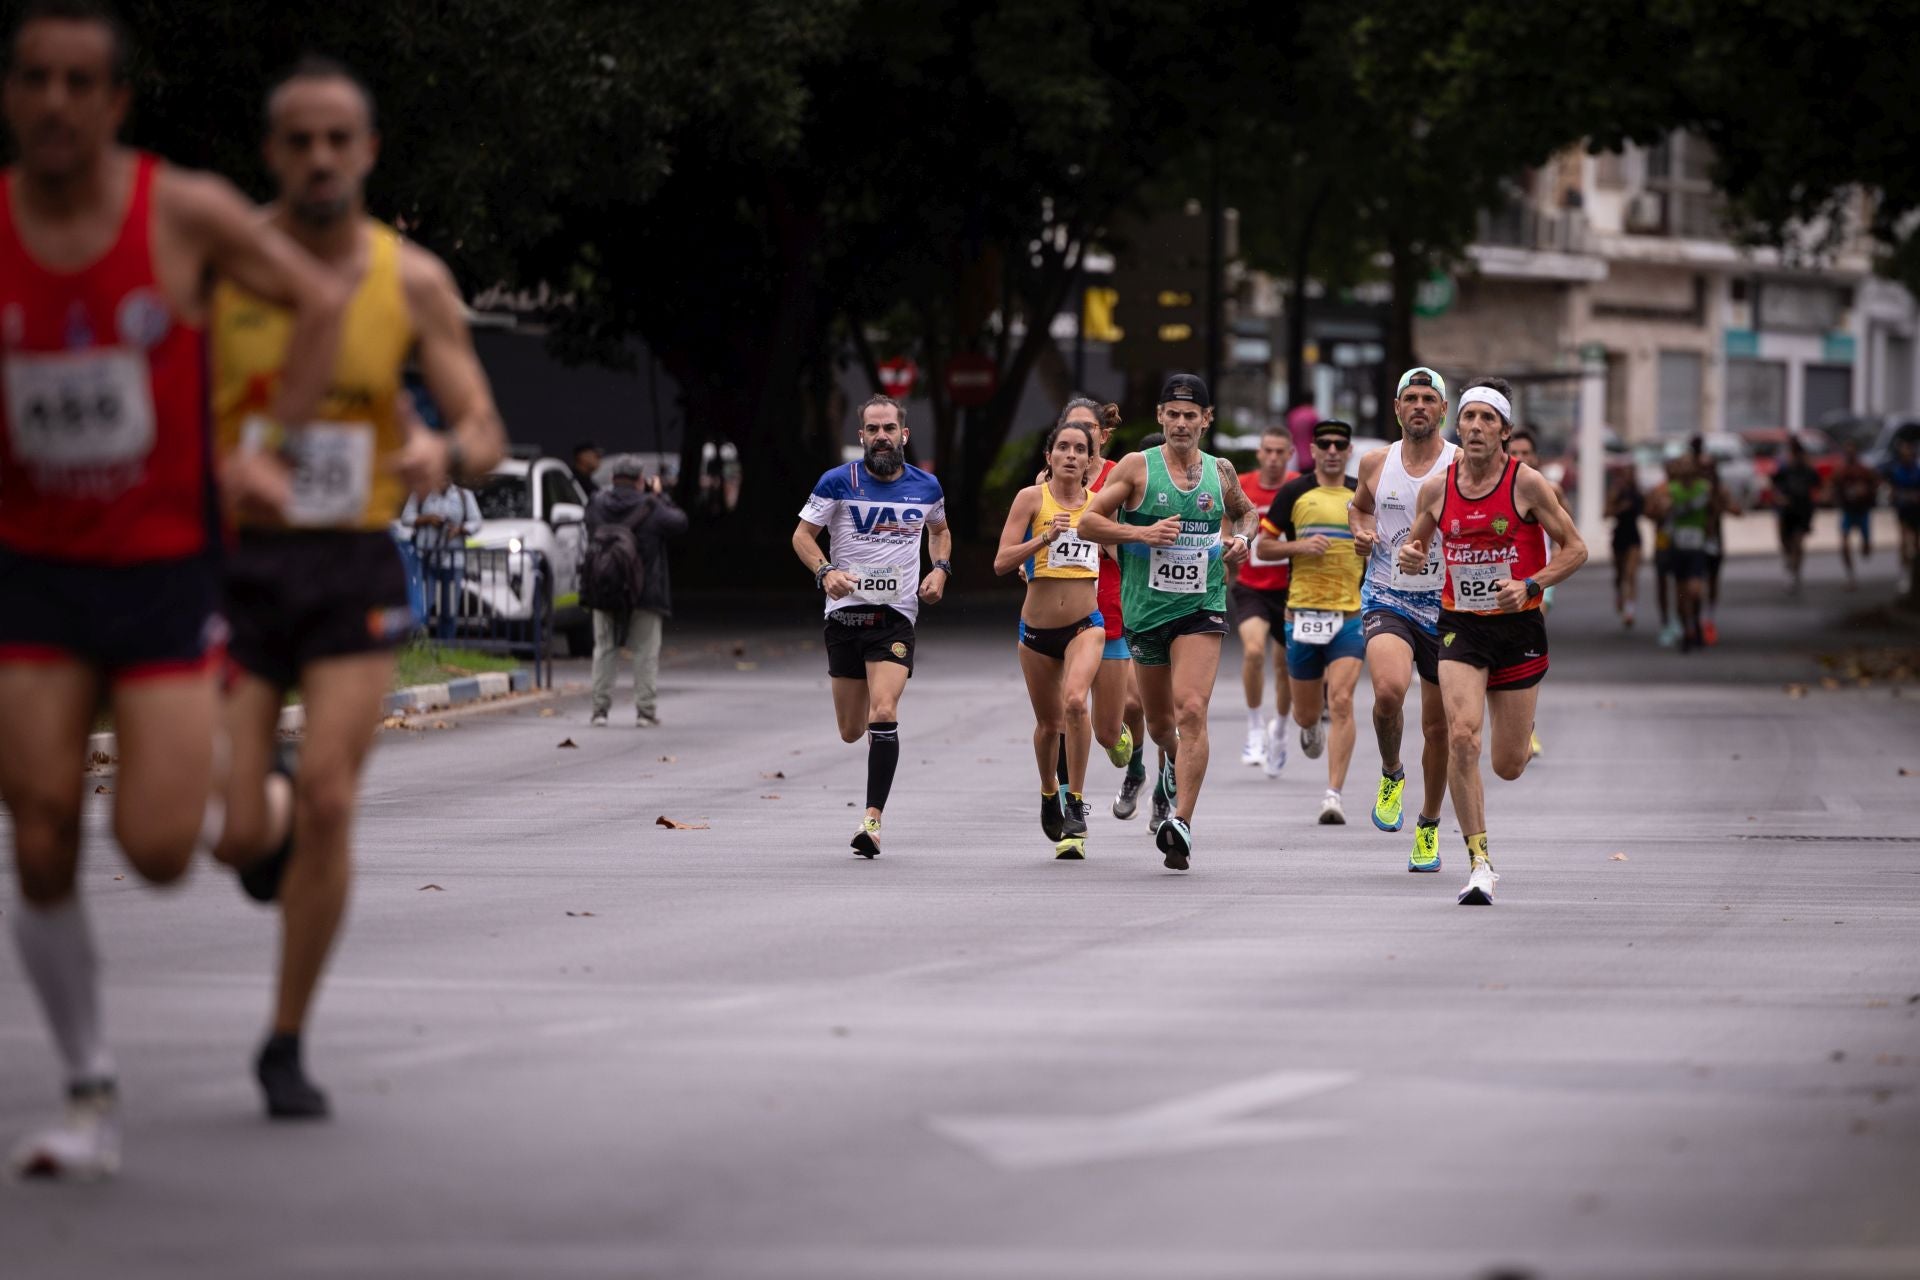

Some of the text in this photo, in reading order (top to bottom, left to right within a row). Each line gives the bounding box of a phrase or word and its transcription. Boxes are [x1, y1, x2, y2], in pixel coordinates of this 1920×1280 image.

[848, 504, 923, 536] VAS
[1180, 521, 1209, 533] TISMO
[1175, 536, 1215, 547] MOLINOS
[1390, 527, 1411, 544] NUEVA
[1056, 542, 1091, 557] 477
[1158, 563, 1199, 580] 403
[857, 578, 897, 591] 1200
[1460, 579, 1502, 597] 624
[1301, 621, 1333, 634] 691
